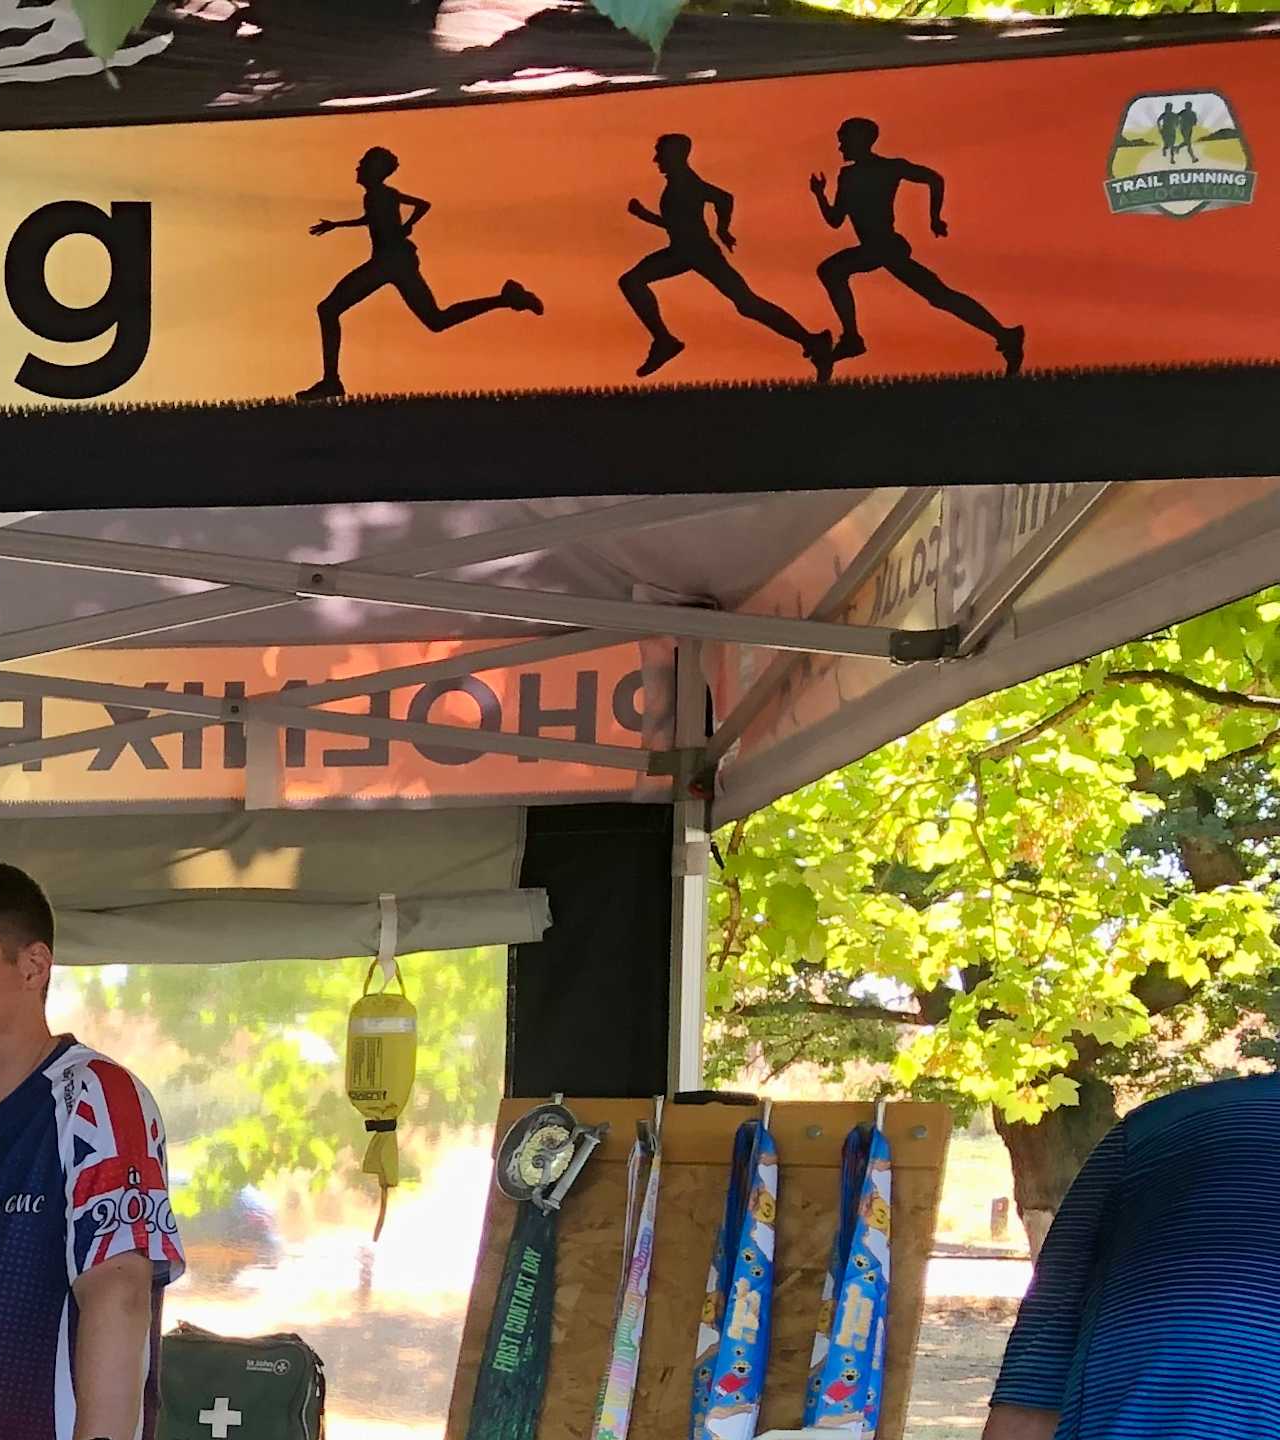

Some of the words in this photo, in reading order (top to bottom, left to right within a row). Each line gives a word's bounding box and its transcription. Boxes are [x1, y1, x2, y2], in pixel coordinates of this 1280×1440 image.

[1111, 175, 1164, 194] TRAIL
[1169, 172, 1247, 187] RUNNING
[520, 1245, 542, 1276] DAY
[503, 1272, 537, 1335] CONTACT
[492, 1333, 522, 1373] FIRST
